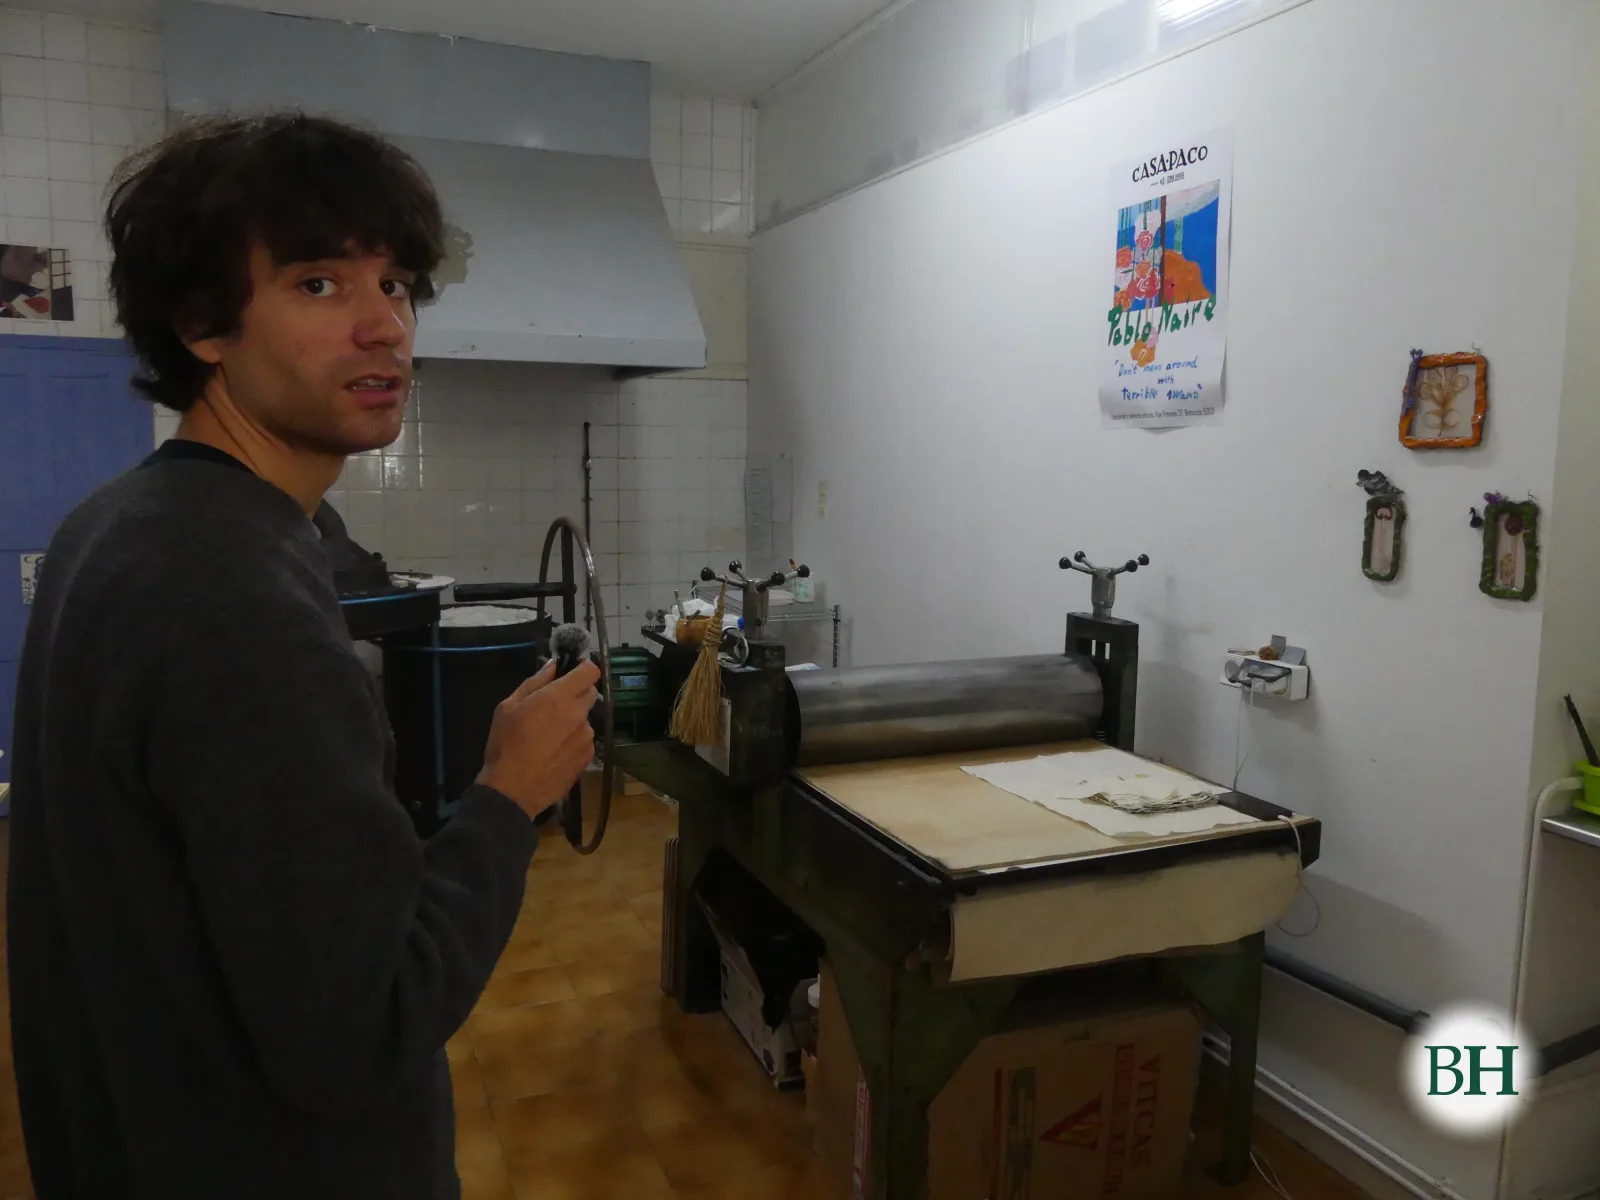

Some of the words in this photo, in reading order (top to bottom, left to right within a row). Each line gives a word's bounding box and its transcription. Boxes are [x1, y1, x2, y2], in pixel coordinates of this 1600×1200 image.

[1107, 304, 1152, 347] Pablo
[1166, 355, 1199, 371] around
[1157, 374, 1175, 385] with
[1121, 386, 1158, 401] terrible
